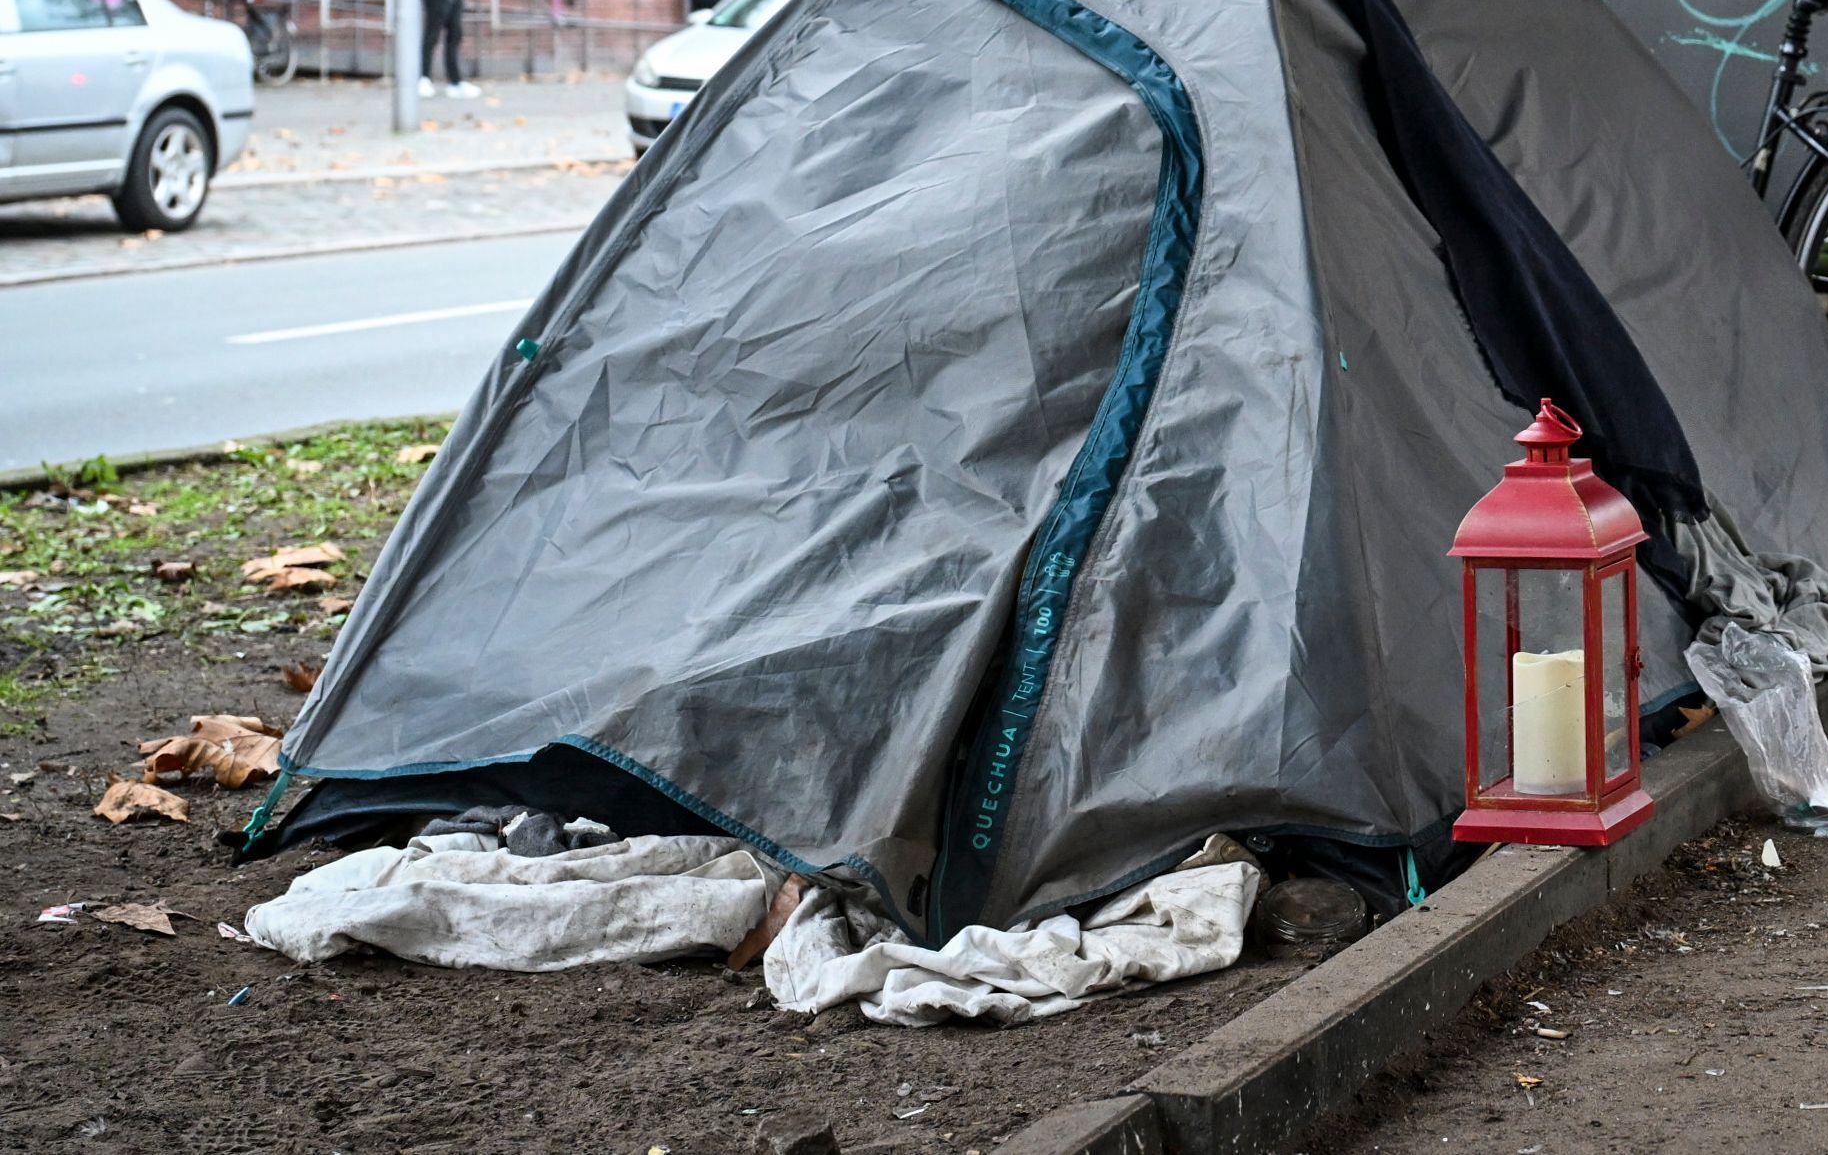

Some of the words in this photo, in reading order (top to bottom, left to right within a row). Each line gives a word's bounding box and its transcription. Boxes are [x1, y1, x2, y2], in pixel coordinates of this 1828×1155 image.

[972, 726, 1018, 850] QUECHUA
[1011, 661, 1037, 701] TENT
[1033, 606, 1053, 636] 100
